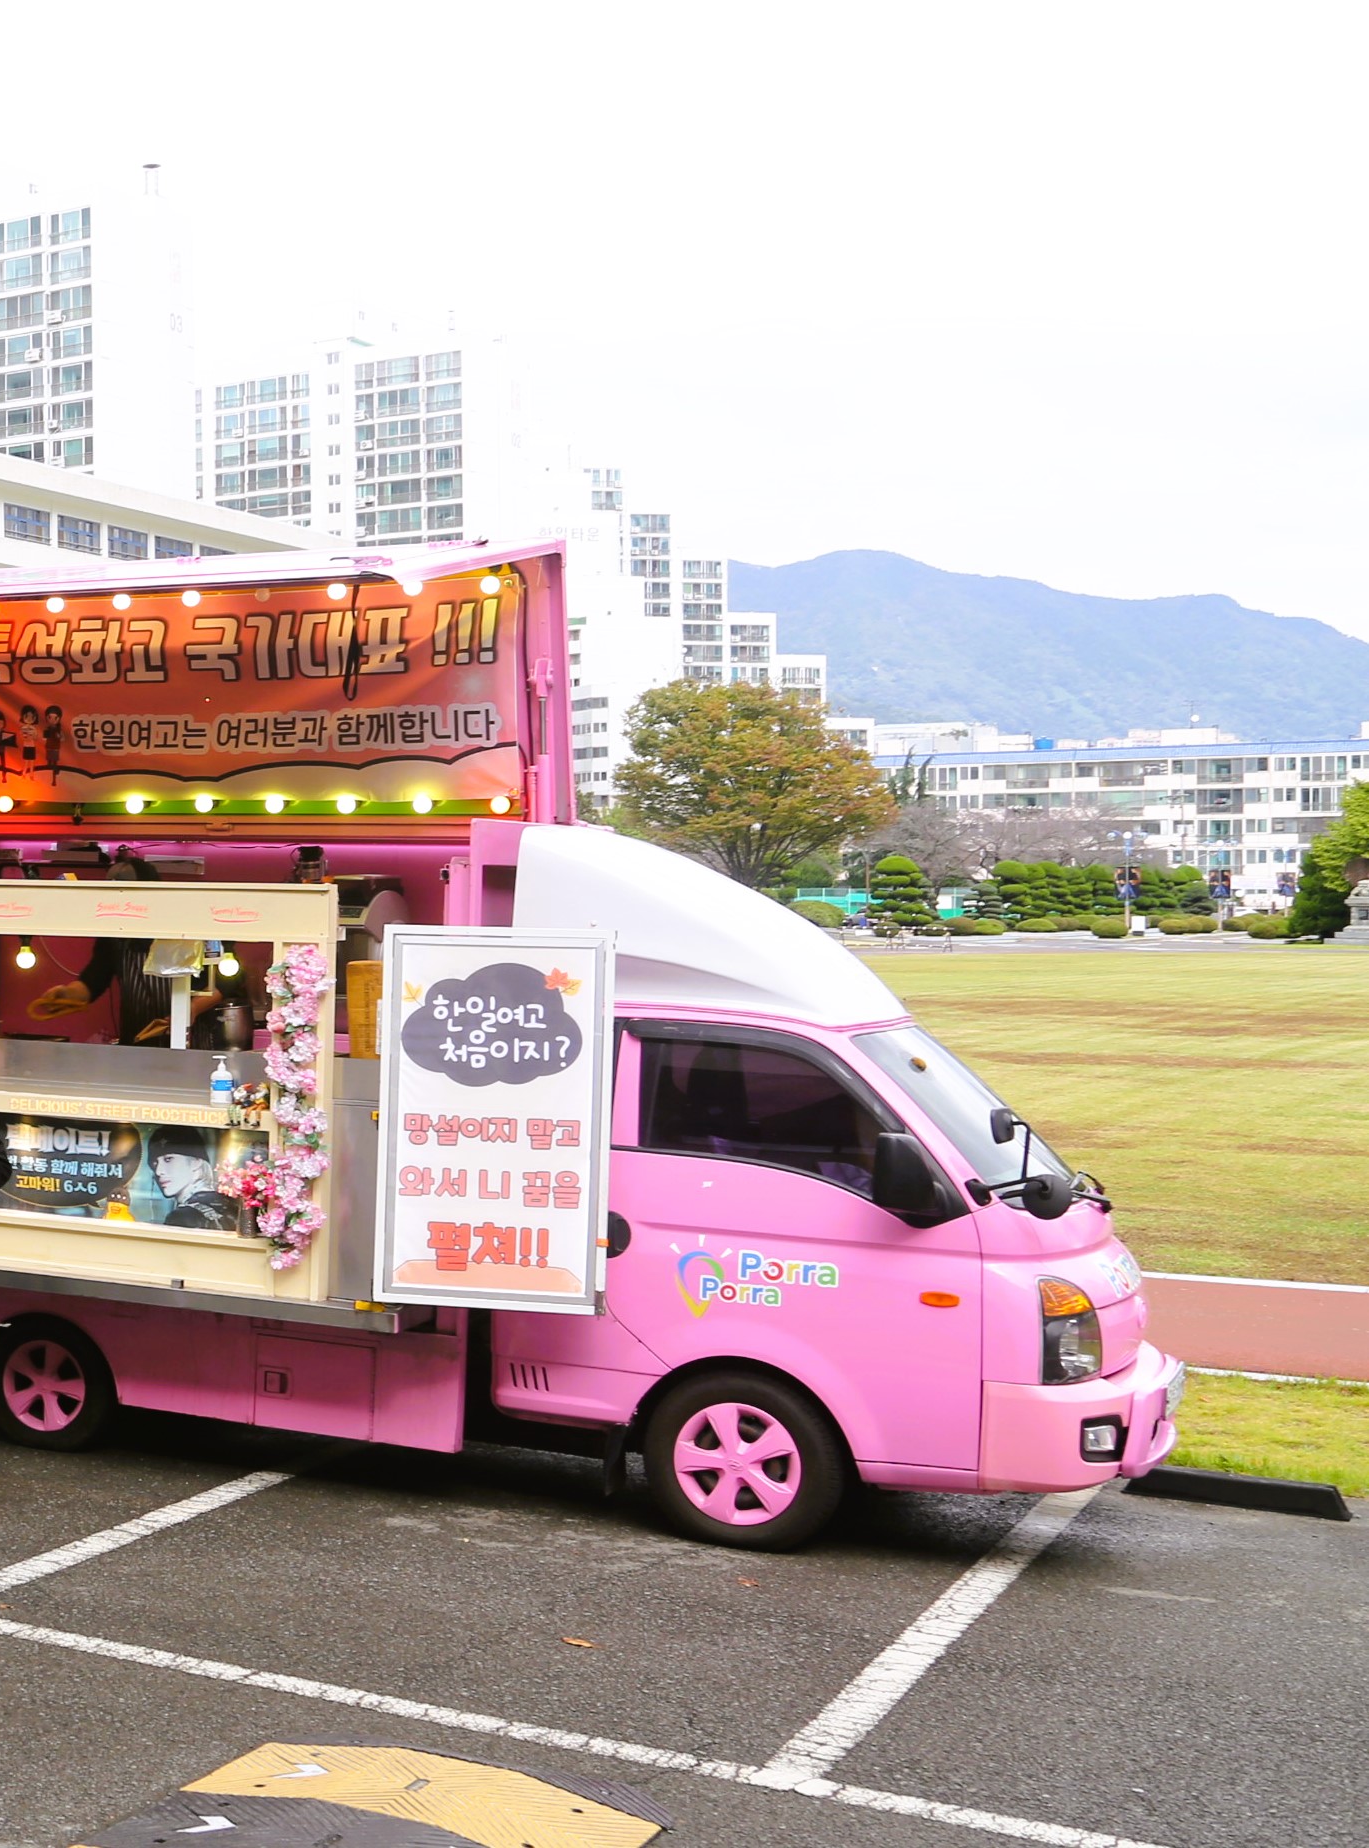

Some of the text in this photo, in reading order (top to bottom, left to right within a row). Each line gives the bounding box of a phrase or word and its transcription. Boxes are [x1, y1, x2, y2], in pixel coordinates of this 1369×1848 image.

[185, 605, 409, 682] 국가대표
[432, 598, 500, 667] !!!
[72, 708, 495, 753] 한일여고는 여러분과 함께합니다
[433, 994, 547, 1033] 한일여고
[439, 1029, 571, 1069] 처음이지?
[85, 1103, 138, 1119] STREET
[141, 1107, 228, 1125] FOODTRUCK
[403, 1113, 581, 1150] 망설이지 말고
[15, 1175, 61, 1192] 고마워!
[20, 1156, 49, 1173] 활동
[50, 1159, 78, 1176] 함께
[81, 1161, 123, 1179] 해줘서
[398, 1165, 582, 1210] 와서 니 꿈을
[427, 1221, 551, 1272] 펼쳐!!
[739, 1251, 838, 1287] Porra
[701, 1276, 780, 1306] Porra
